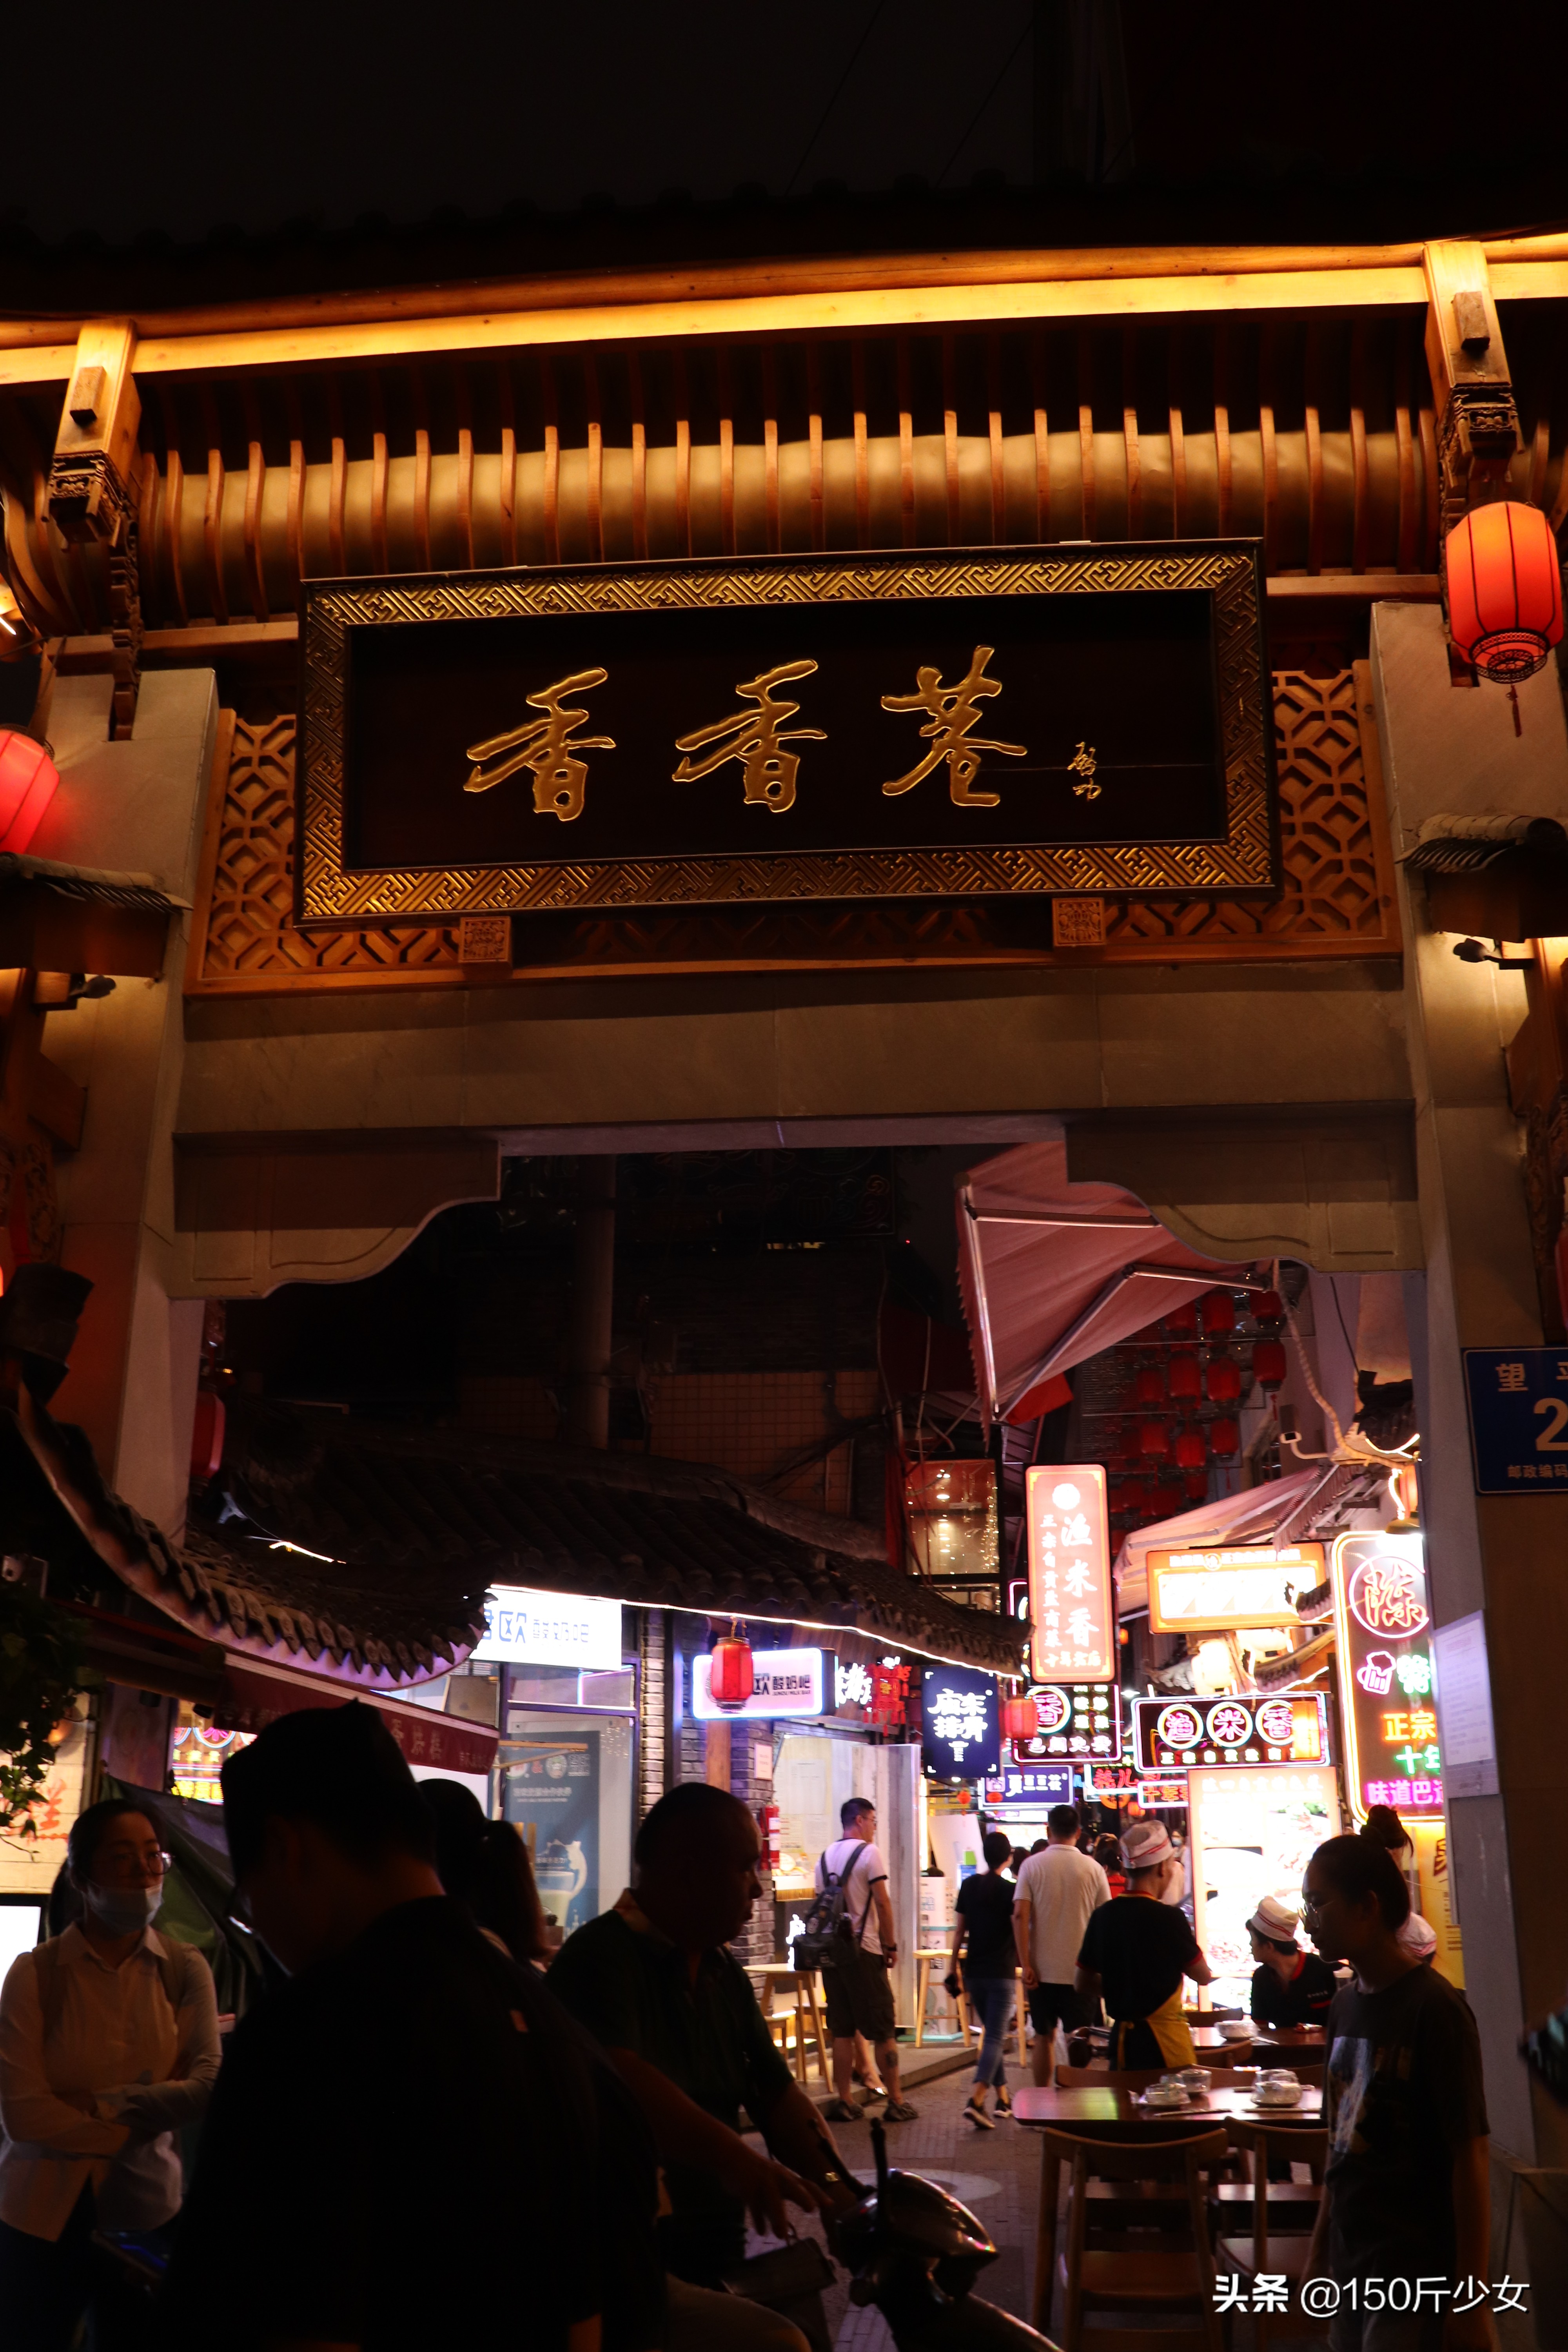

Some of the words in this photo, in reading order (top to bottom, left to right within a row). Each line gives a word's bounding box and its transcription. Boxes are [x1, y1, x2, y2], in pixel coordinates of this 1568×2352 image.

[463, 644, 1028, 822] 香香巷
[1507, 1465, 1568, 1479] 邮政编码
[1061, 1513, 1100, 1647] 渔米香
[933, 1715, 988, 1742] 排骨
[1165, 1708, 1293, 1741] 渔米香
[1383, 1710, 1437, 1741] 正宗
